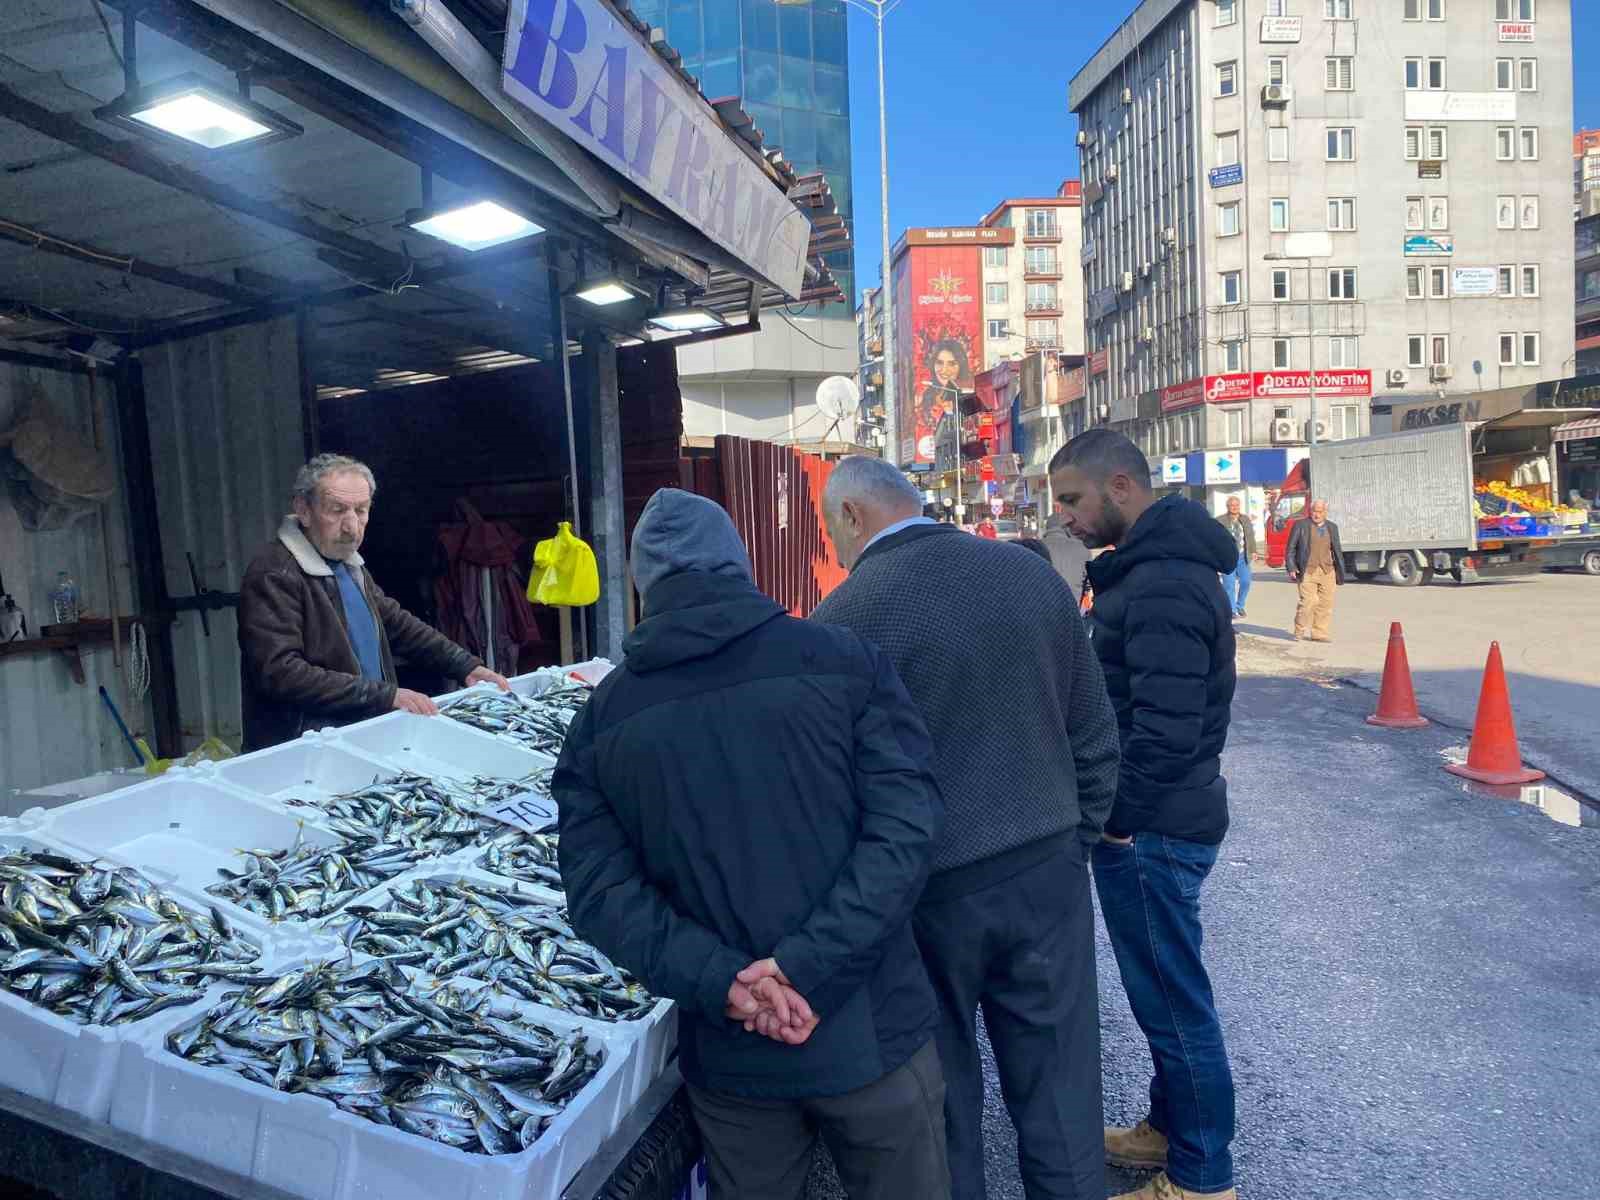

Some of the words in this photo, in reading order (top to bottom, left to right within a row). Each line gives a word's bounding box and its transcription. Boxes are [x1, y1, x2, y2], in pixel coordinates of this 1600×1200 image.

[1502, 25, 1532, 33] AVUKAT
[1225, 378, 1250, 387] DETAY
[1275, 375, 1312, 387] DETAY
[1315, 372, 1368, 386] YÖNETİM
[496, 801, 552, 825] 70
